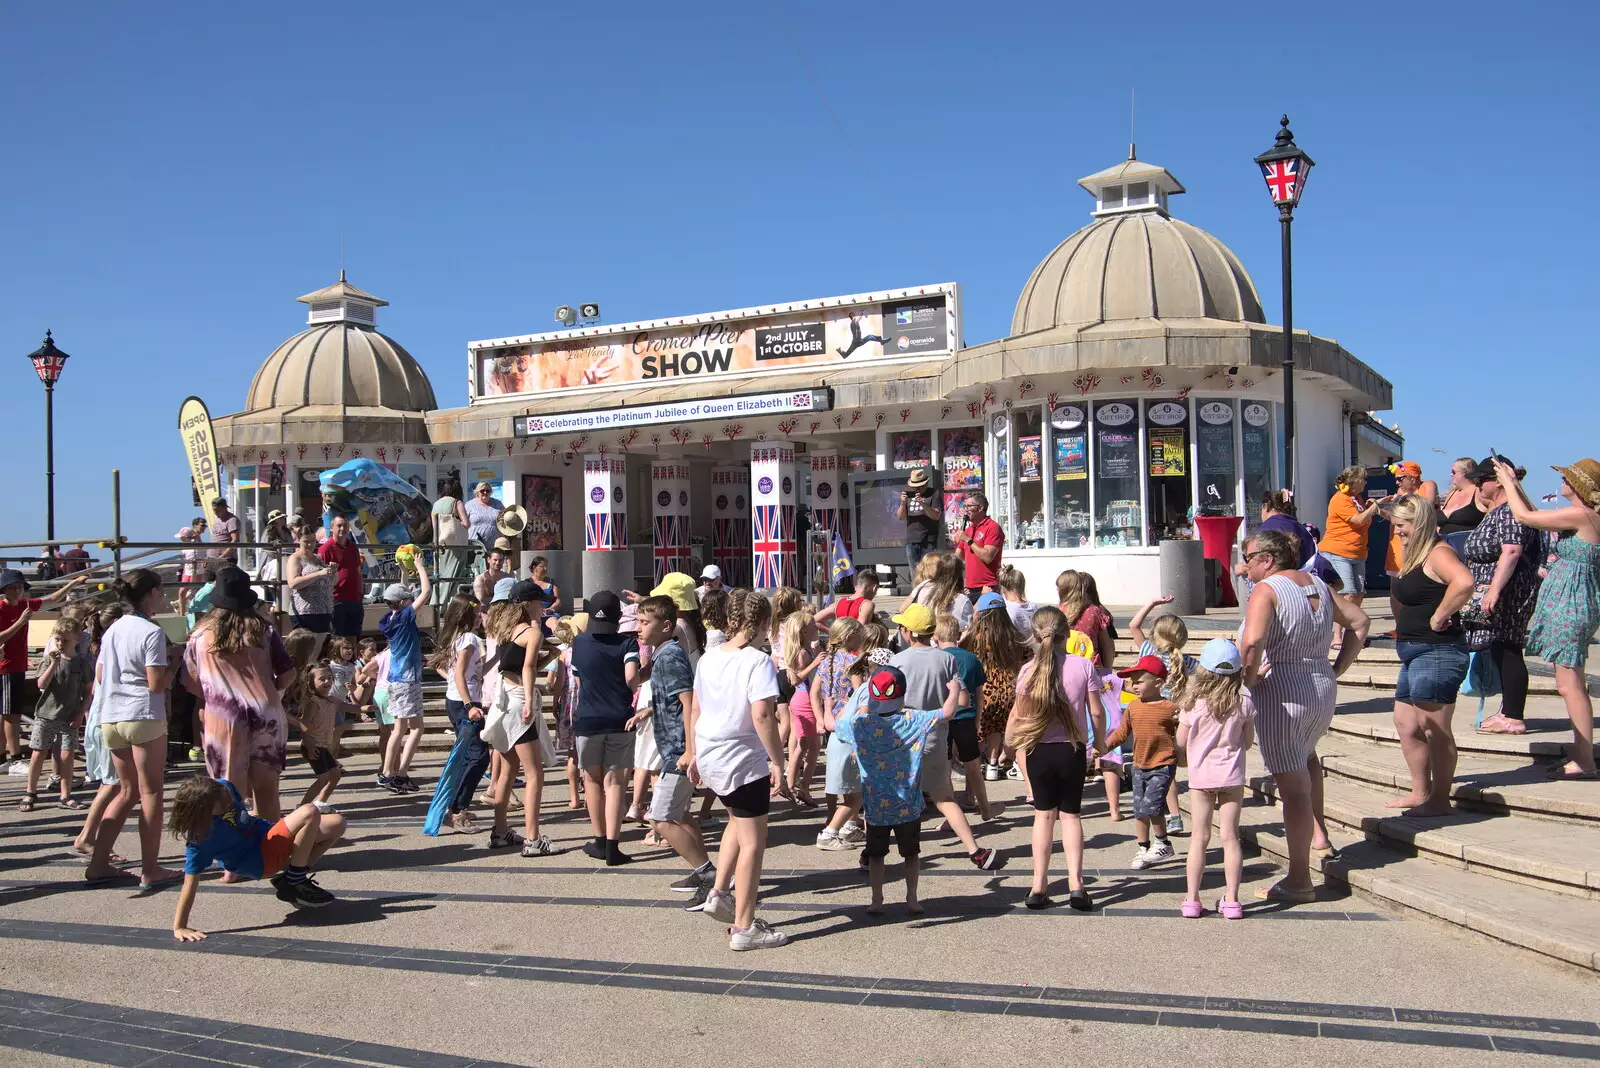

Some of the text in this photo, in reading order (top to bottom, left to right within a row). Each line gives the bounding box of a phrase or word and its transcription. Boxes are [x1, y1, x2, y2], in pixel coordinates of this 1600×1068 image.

[632, 323, 746, 355] Cromer Pier
[765, 333, 782, 345] 2nd
[783, 330, 808, 342] JULY
[909, 336, 936, 346] openwide
[567, 347, 616, 361] Live Variety
[760, 340, 823, 356] 1st OCTOBER
[642, 348, 734, 380] SHOW
[544, 397, 792, 430] Celebrating the Platinum Jubilee of Queen Elizabeth II
[946, 460, 979, 470] SHOW
[527, 519, 561, 533] SHOW
[1236, 1001, 1341, 1014] November
[1427, 1013, 1472, 1024] lives
[1478, 1018, 1538, 1030] saved
